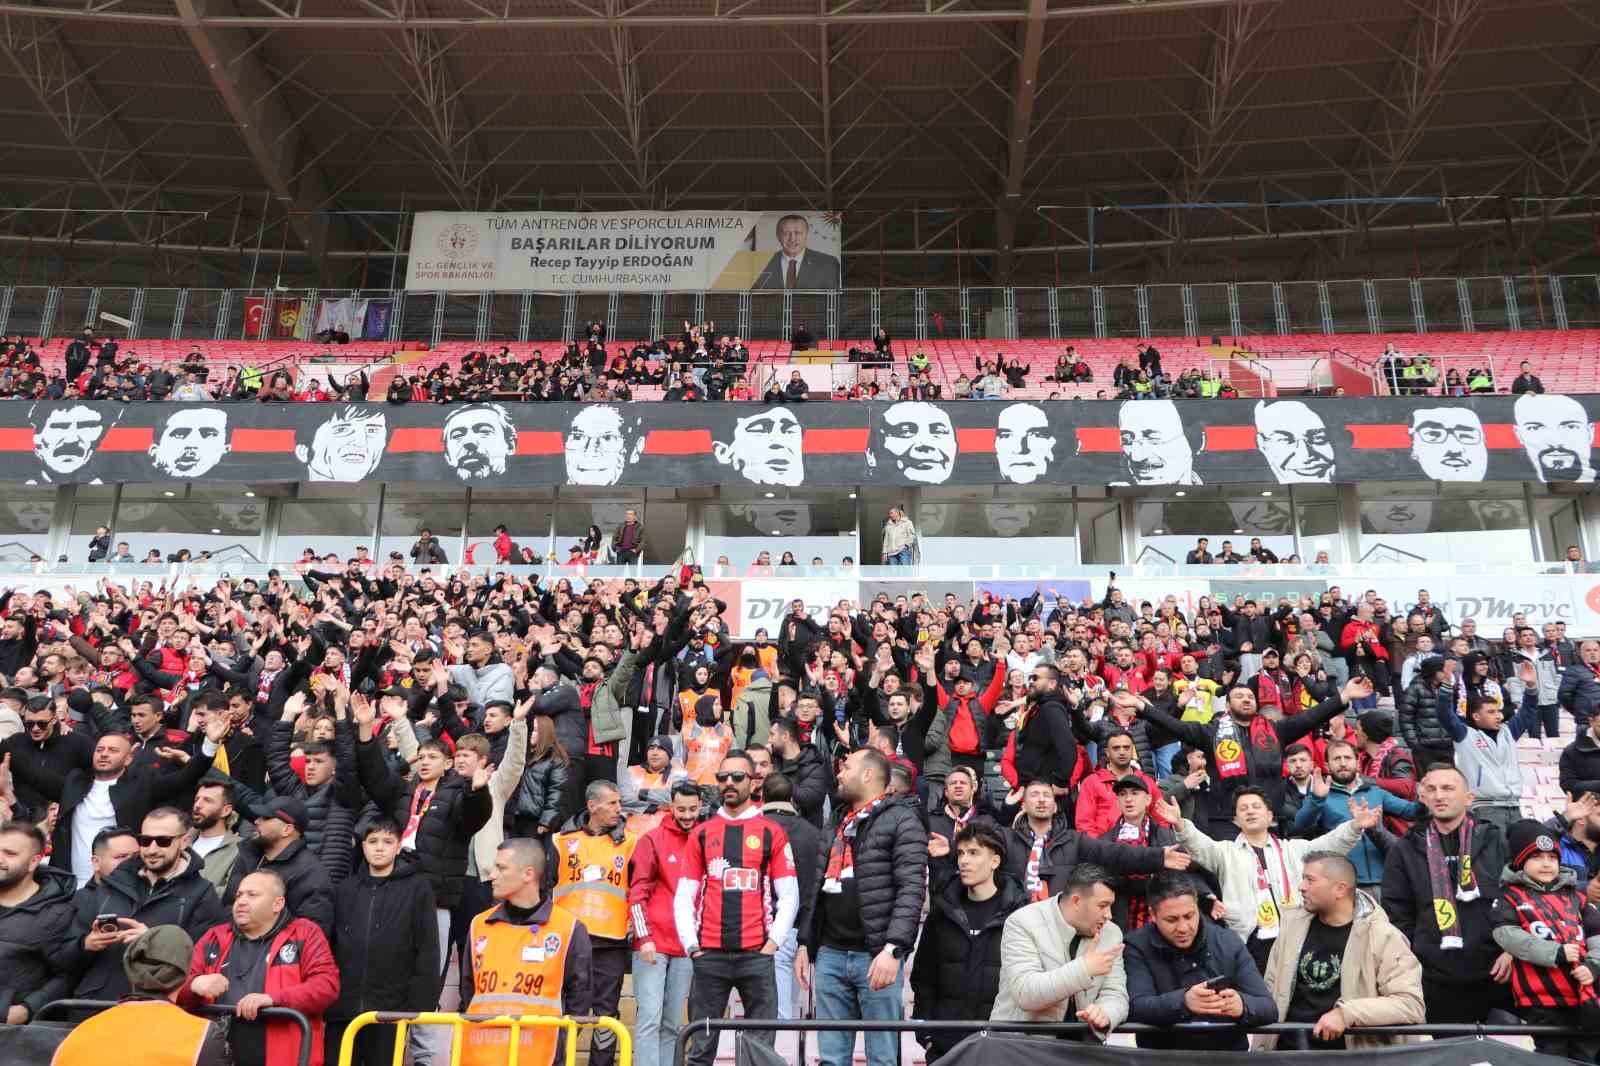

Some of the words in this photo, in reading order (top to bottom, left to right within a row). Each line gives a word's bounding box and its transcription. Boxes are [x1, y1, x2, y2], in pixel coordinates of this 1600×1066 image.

[486, 216, 517, 230] TÜM
[521, 216, 598, 230] ANTRENÖR
[601, 217, 618, 230] VE
[620, 216, 744, 230] SPORCULARIMIZA
[511, 237, 611, 253] BAŞARILAR
[615, 235, 715, 250] DİLİYORUM
[482, 261, 494, 269] VE
[530, 256, 570, 269] Recep
[575, 256, 619, 270] Tayyip
[622, 253, 694, 267] ERDOĞAN
[551, 274, 569, 284] T.C.
[572, 273, 671, 285] CUMHURBAŞKANI
[511, 971, 544, 996] 299
